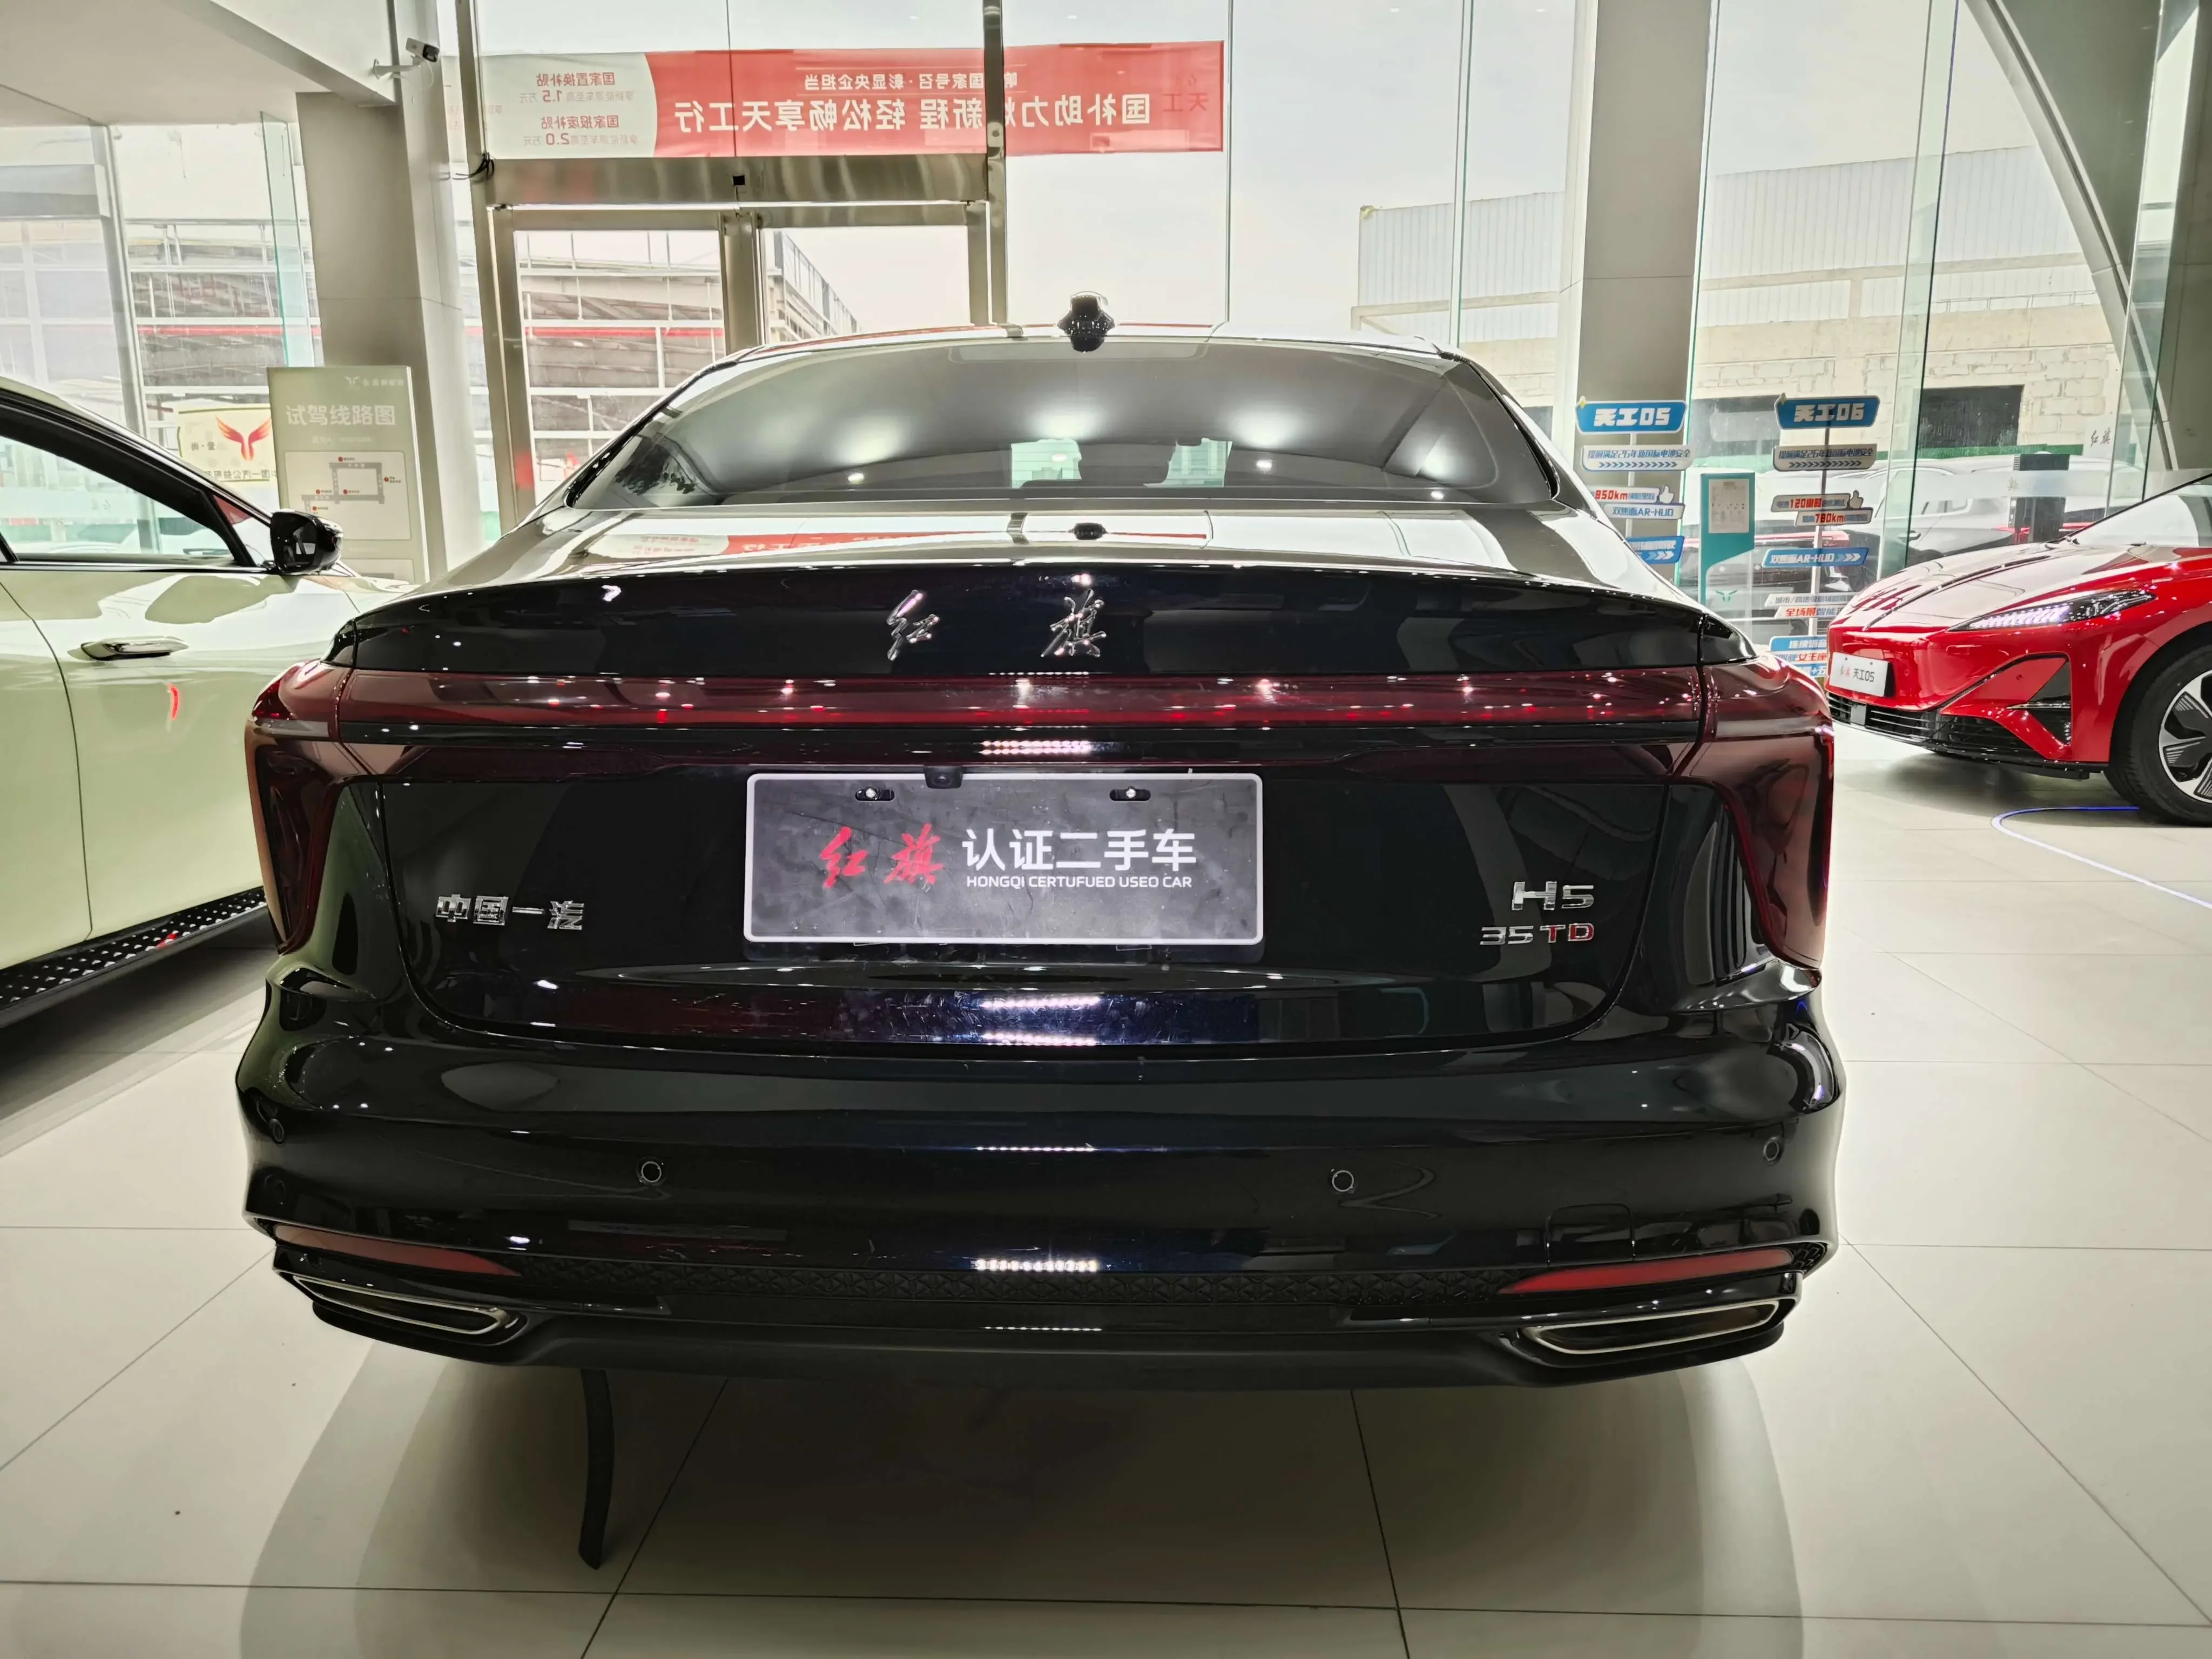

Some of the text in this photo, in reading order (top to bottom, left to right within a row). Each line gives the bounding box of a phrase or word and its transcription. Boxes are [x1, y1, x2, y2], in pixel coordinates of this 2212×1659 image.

[286, 404, 396, 426] 试驾线路图
[1594, 407, 1671, 427] 天工05
[1793, 403, 1865, 422] 天工06
[1853, 667, 1875, 683] 天工05
[819, 822, 1198, 889] 红旗 认证二手车
[967, 875, 1025, 889] HONGQI
[1162, 875, 1192, 888] CAR
[1512, 881, 1595, 911] H5
[436, 894, 585, 930] 中国一汽
[1479, 922, 1595, 945] 35TD
